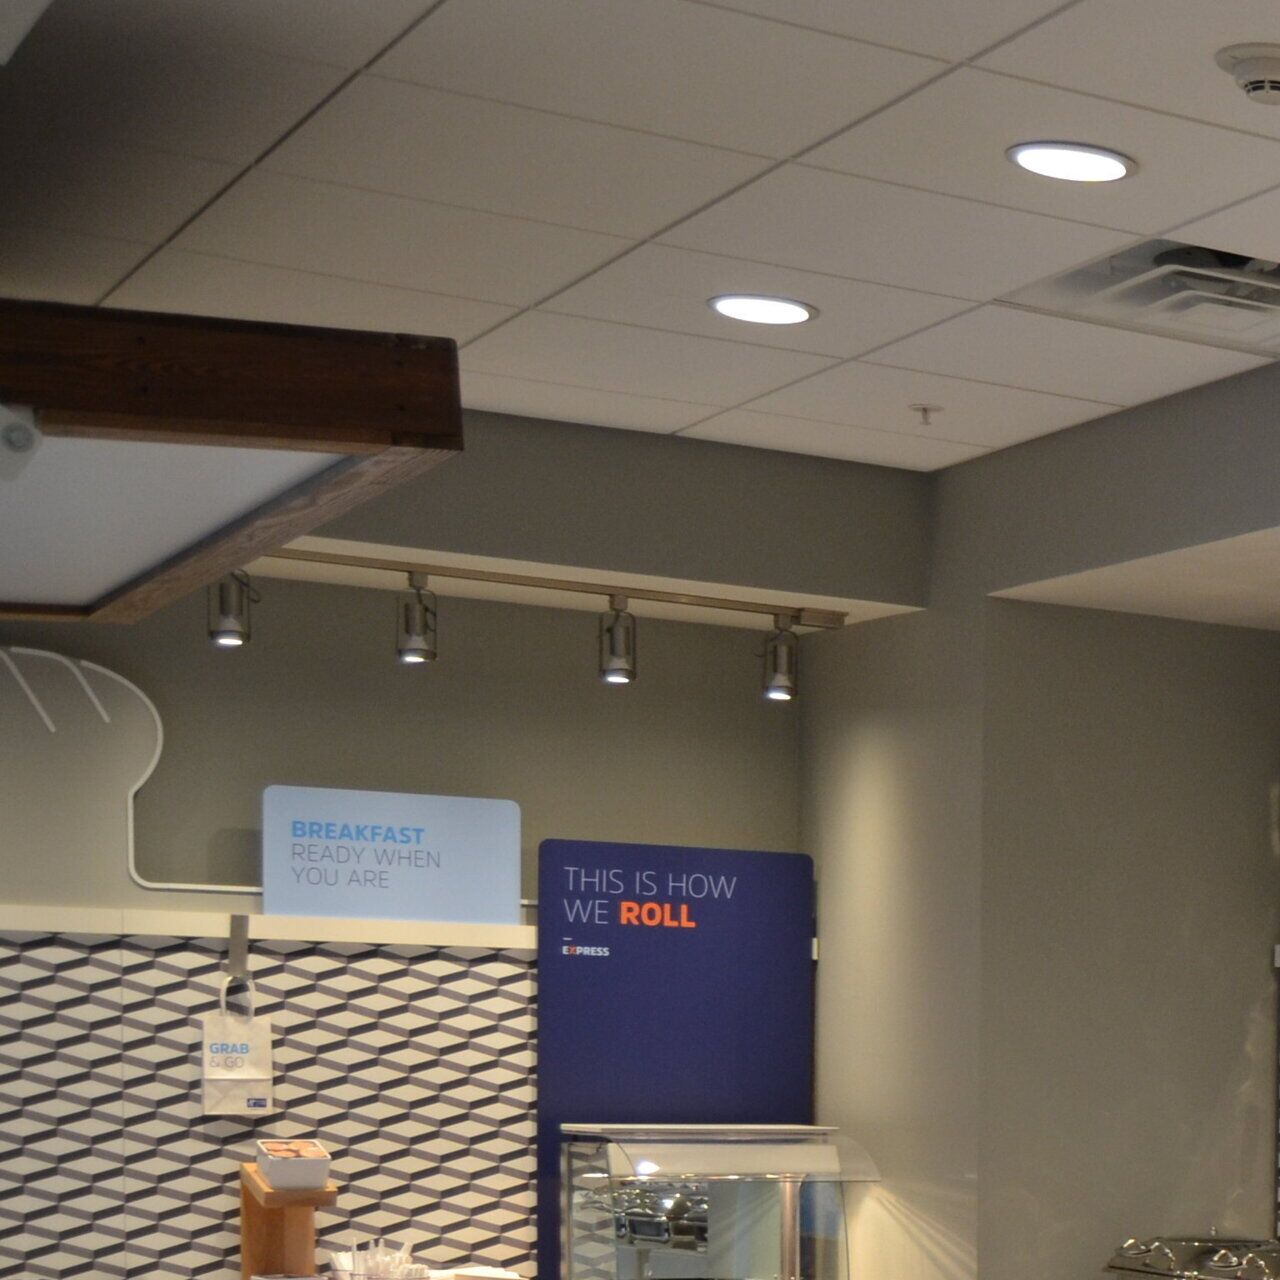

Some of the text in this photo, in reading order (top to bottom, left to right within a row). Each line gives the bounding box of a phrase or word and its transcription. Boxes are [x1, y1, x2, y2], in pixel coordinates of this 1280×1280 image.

[291, 820, 425, 844] BREAKFAST
[291, 843, 441, 868] READY WHEN
[291, 866, 390, 888] YOU ARE
[563, 866, 737, 899] THIS IS HOW
[563, 898, 696, 928] WE ROLL
[562, 945, 610, 956] EXPRESS
[209, 1043, 249, 1054] GRAB
[209, 1056, 244, 1068] & GO
